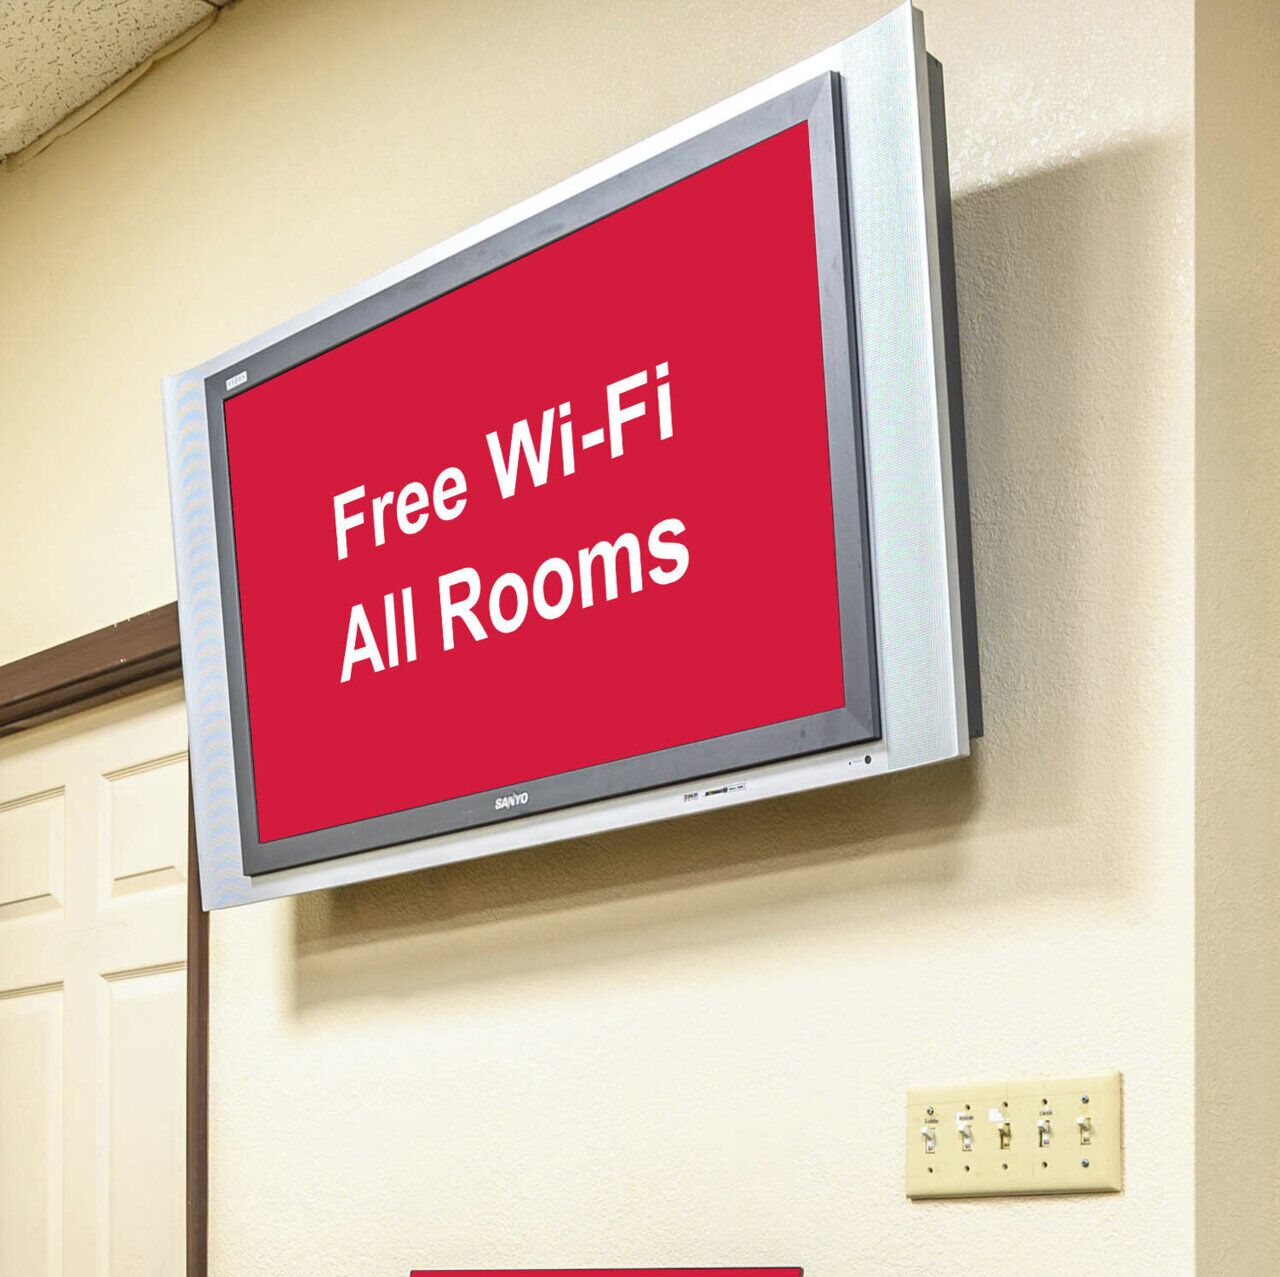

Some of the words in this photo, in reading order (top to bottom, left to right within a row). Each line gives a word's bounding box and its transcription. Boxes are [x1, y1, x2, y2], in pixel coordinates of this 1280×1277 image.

[333, 467, 468, 561] Free
[486, 362, 674, 500] Wi-Fi
[340, 587, 418, 684] All
[438, 517, 690, 652] Rooms
[494, 792, 529, 810] SANYO
